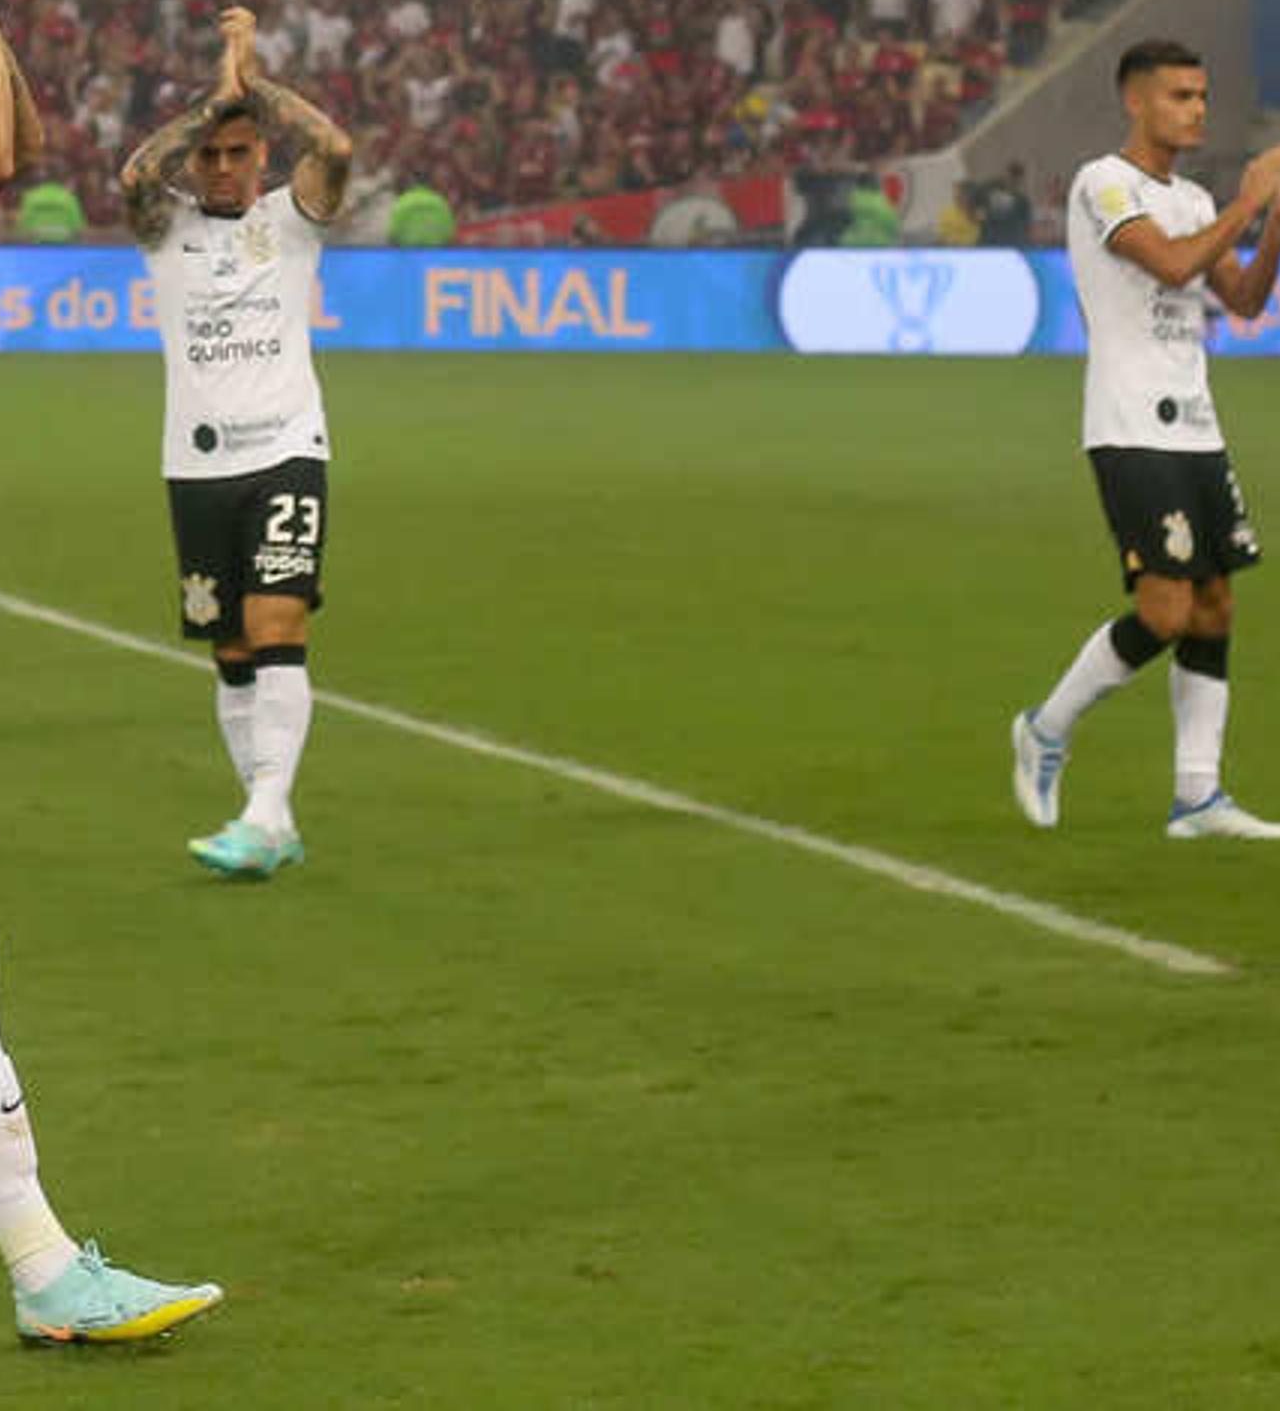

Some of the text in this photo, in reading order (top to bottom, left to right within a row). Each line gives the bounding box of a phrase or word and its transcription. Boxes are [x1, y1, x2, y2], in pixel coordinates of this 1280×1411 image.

[48, 278, 115, 329] do
[425, 267, 651, 336] FINAL
[266, 494, 320, 544] 23
